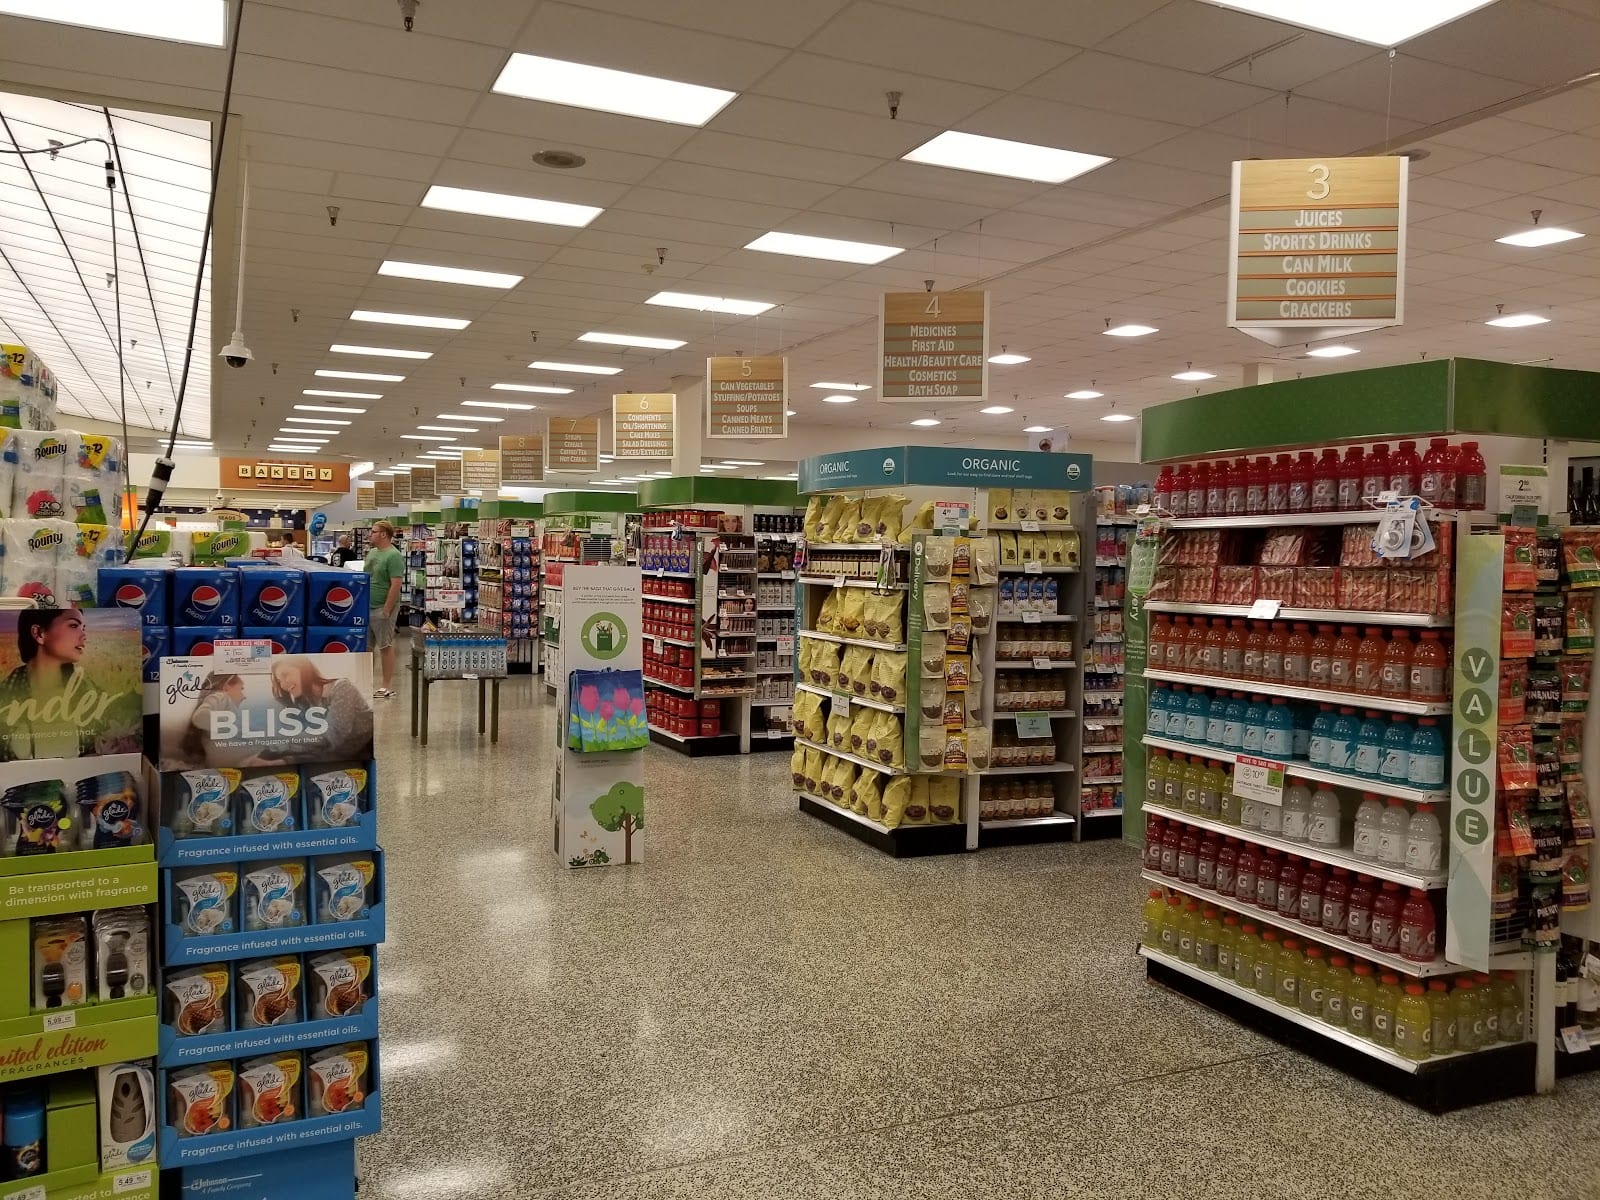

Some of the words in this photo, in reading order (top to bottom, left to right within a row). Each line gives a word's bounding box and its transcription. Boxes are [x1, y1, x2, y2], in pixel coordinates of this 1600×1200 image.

[1306, 163, 1330, 200] 3
[1295, 209, 1343, 226] JUICES
[1264, 233, 1316, 250] SPORTS
[1319, 232, 1372, 249] DRINKS
[1282, 256, 1314, 273] CAN
[1317, 255, 1353, 272] MILK
[1286, 279, 1346, 296] COOKIES
[925, 295, 942, 318] 4
[1279, 301, 1352, 318] CRACKERS
[910, 325, 957, 337] MEDICINES
[911, 339, 936, 352] FIRST
[938, 339, 955, 351] AID
[12, 352, 25, 364] 12
[884, 354, 958, 368] HEALTH/BEAUTY
[959, 354, 982, 366] CARE
[742, 360, 752, 377] 5
[909, 370, 957, 382] COSMETICS
[720, 382, 735, 391] CAN
[736, 382, 775, 391] VEGETABLES
[908, 384, 933, 396] BATH
[934, 383, 958, 395] SOAP
[640, 396, 649, 410] 6
[713, 392, 781, 402] STUFFING/POTATOES
[736, 403, 757, 413] SOUPS
[567, 419, 577, 433] 7
[722, 414, 748, 424] CANNED
[750, 414, 773, 424] MEATS
[722, 425, 749, 434] CANNED
[750, 425, 773, 434] FRUITS
[518, 437, 525, 448] 8
[34, 443, 67, 461] Bounty
[819, 461, 850, 475] ORGANIC
[962, 457, 1021, 471] ORGANIC
[241, 466, 330, 479] BAKERY
[39, 501, 50, 509] 2X
[27, 533, 63, 552] Bounty
[136, 534, 160, 549] ounty
[210, 536, 239, 556] Bounty
[912, 557, 921, 601] Delivery
[146, 615, 156, 624] 12
[185, 607, 207, 621] pepsi
[221, 615, 231, 624] 12
[253, 608, 274, 622] pepsi
[288, 616, 297, 625] 12
[320, 608, 339, 622] pepsi
[353, 617, 362, 625] 12
[1150, 644, 1157, 656] G
[1245, 653, 1252, 665] G
[1311, 660, 1321, 672] G
[1356, 665, 1363, 678] G
[1411, 669, 1420, 683] G
[209, 706, 329, 740] BLISS
[255, 739, 290, 747] fragrance
[1464, 655, 1487, 838] VALUE
[195, 778, 223, 792] glade
[255, 784, 284, 800] glade
[325, 780, 352, 795] glade
[1165, 783, 1173, 795] G
[28, 809, 54, 825] glade
[103, 805, 128, 821] glade
[177, 848, 231, 859] Fragrance
[233, 844, 270, 854] infused
[272, 841, 293, 850] with
[295, 838, 338, 849] essential
[340, 836, 360, 845] oils.
[1150, 846, 1159, 857] G
[1199, 863, 1206, 874] G
[9, 886, 24, 895] Be
[28, 878, 94, 893] transported
[98, 877, 110, 885] to
[261, 876, 287, 892] glade
[332, 873, 359, 889] glade
[5, 893, 65, 907] dimension
[68, 889, 93, 900] with
[96, 884, 148, 897] fragrance
[192, 885, 219, 902] glade
[1301, 896, 1309, 910] G
[1349, 911, 1359, 925] G
[1401, 927, 1409, 941] G
[186, 943, 239, 956] Fragrance
[241, 939, 278, 950] infused
[280, 936, 302, 946] with
[304, 932, 346, 944] essential
[348, 930, 367, 939] oils.
[1181, 938, 1190, 950] G
[329, 970, 355, 986] glade
[257, 978, 284, 994] glade
[1283, 979, 1295, 992] G
[183, 986, 211, 1004] glade
[1329, 998, 1341, 1012] G
[1375, 1015, 1387, 1030] G
[1487, 1015, 1498, 1030] G
[46, 1033, 108, 1060] edition
[178, 1043, 232, 1057] Fragrance
[234, 1038, 271, 1049] infused
[273, 1034, 295, 1045] with
[297, 1028, 340, 1041] essential
[342, 1025, 361, 1034] oils.
[0, 1056, 85, 1076] FRAGRANCES
[326, 1067, 351, 1083] glade
[256, 1075, 284, 1094] glade
[188, 1085, 216, 1104] glade
[181, 1144, 234, 1159] Fragrance
[236, 1138, 273, 1150] infused
[275, 1133, 297, 1144] with
[299, 1126, 342, 1139] essential
[344, 1122, 363, 1132] oils.
